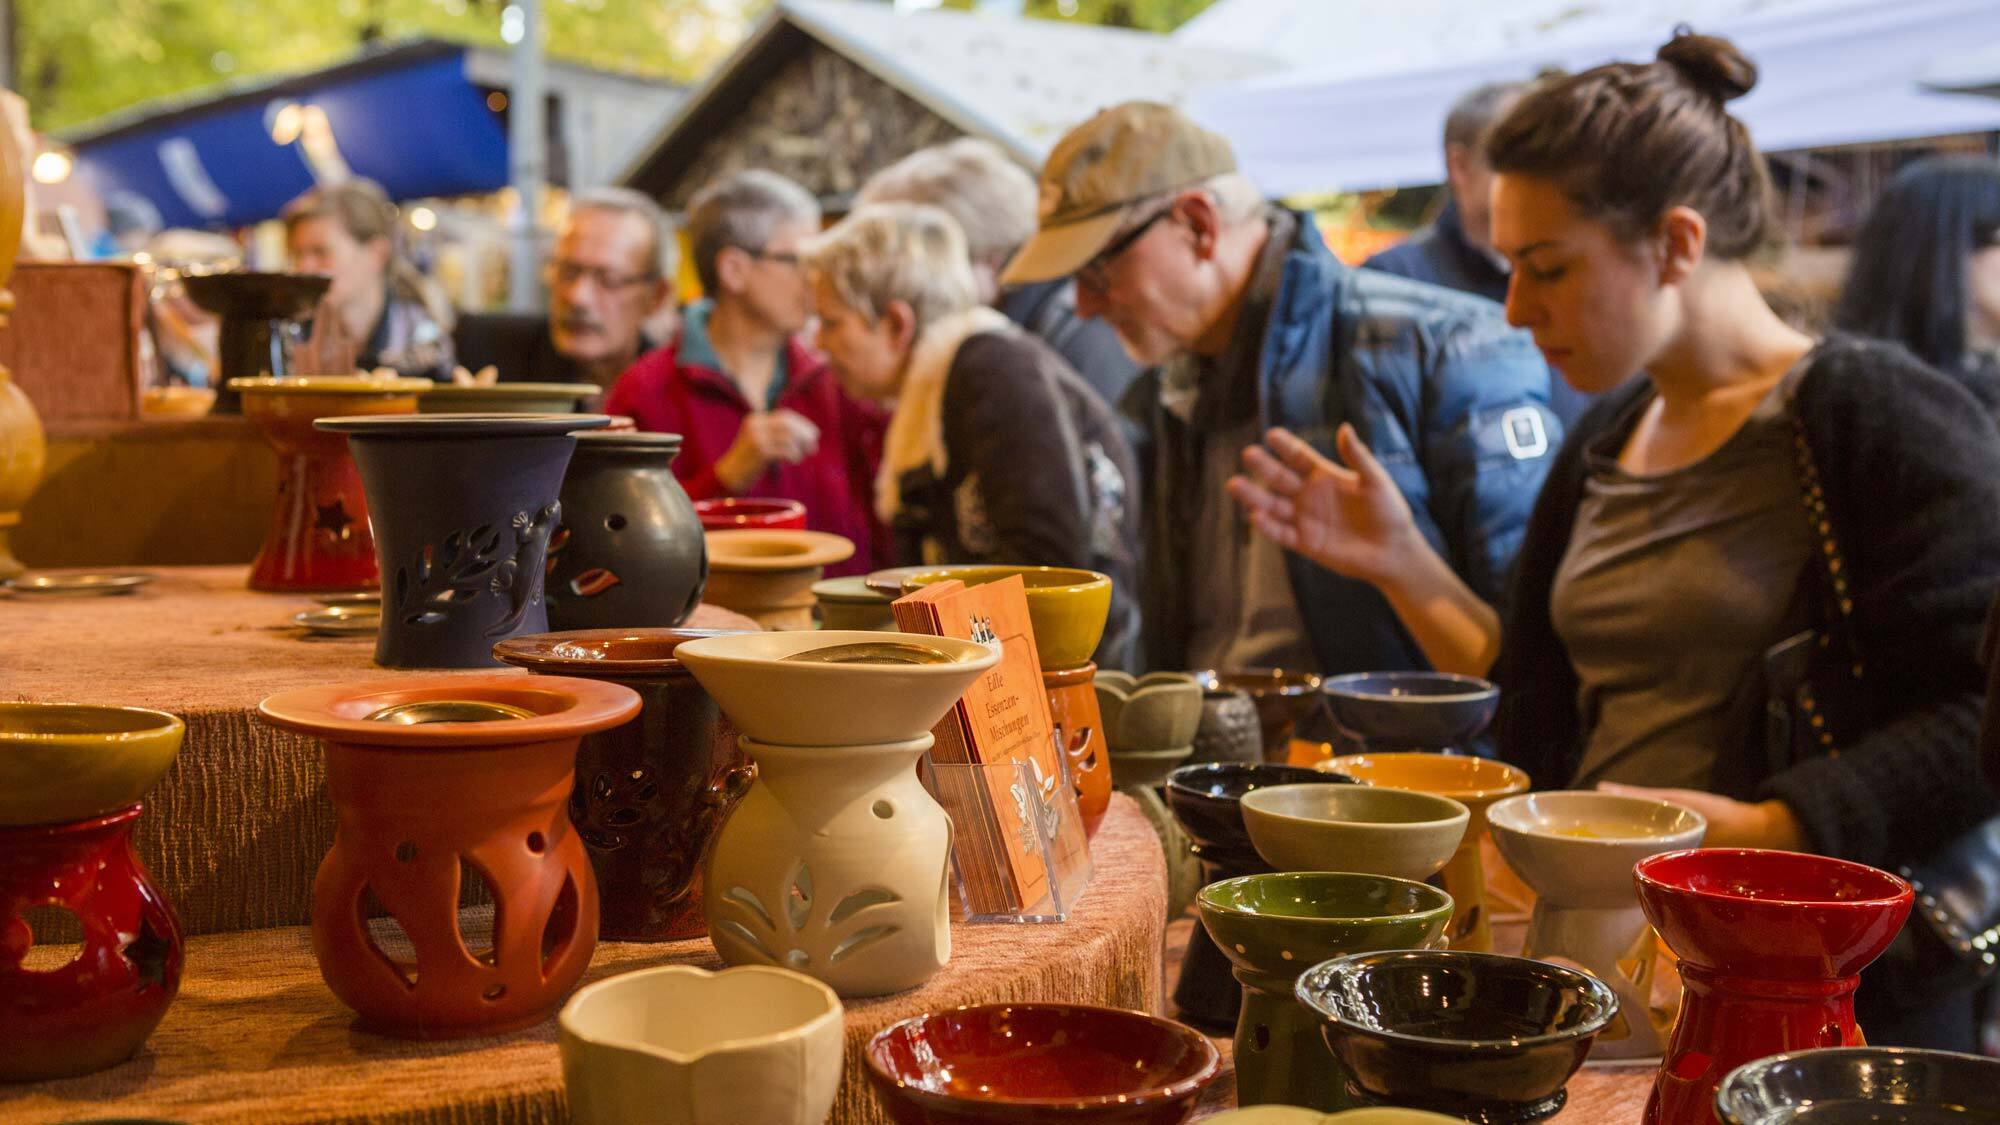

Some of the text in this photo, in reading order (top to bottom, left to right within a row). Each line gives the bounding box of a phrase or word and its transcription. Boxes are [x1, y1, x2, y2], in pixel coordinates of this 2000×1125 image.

[986, 672, 1003, 692] Edle
[985, 696, 1019, 719] Essenzen-
[989, 714, 1030, 744] Mischungen
